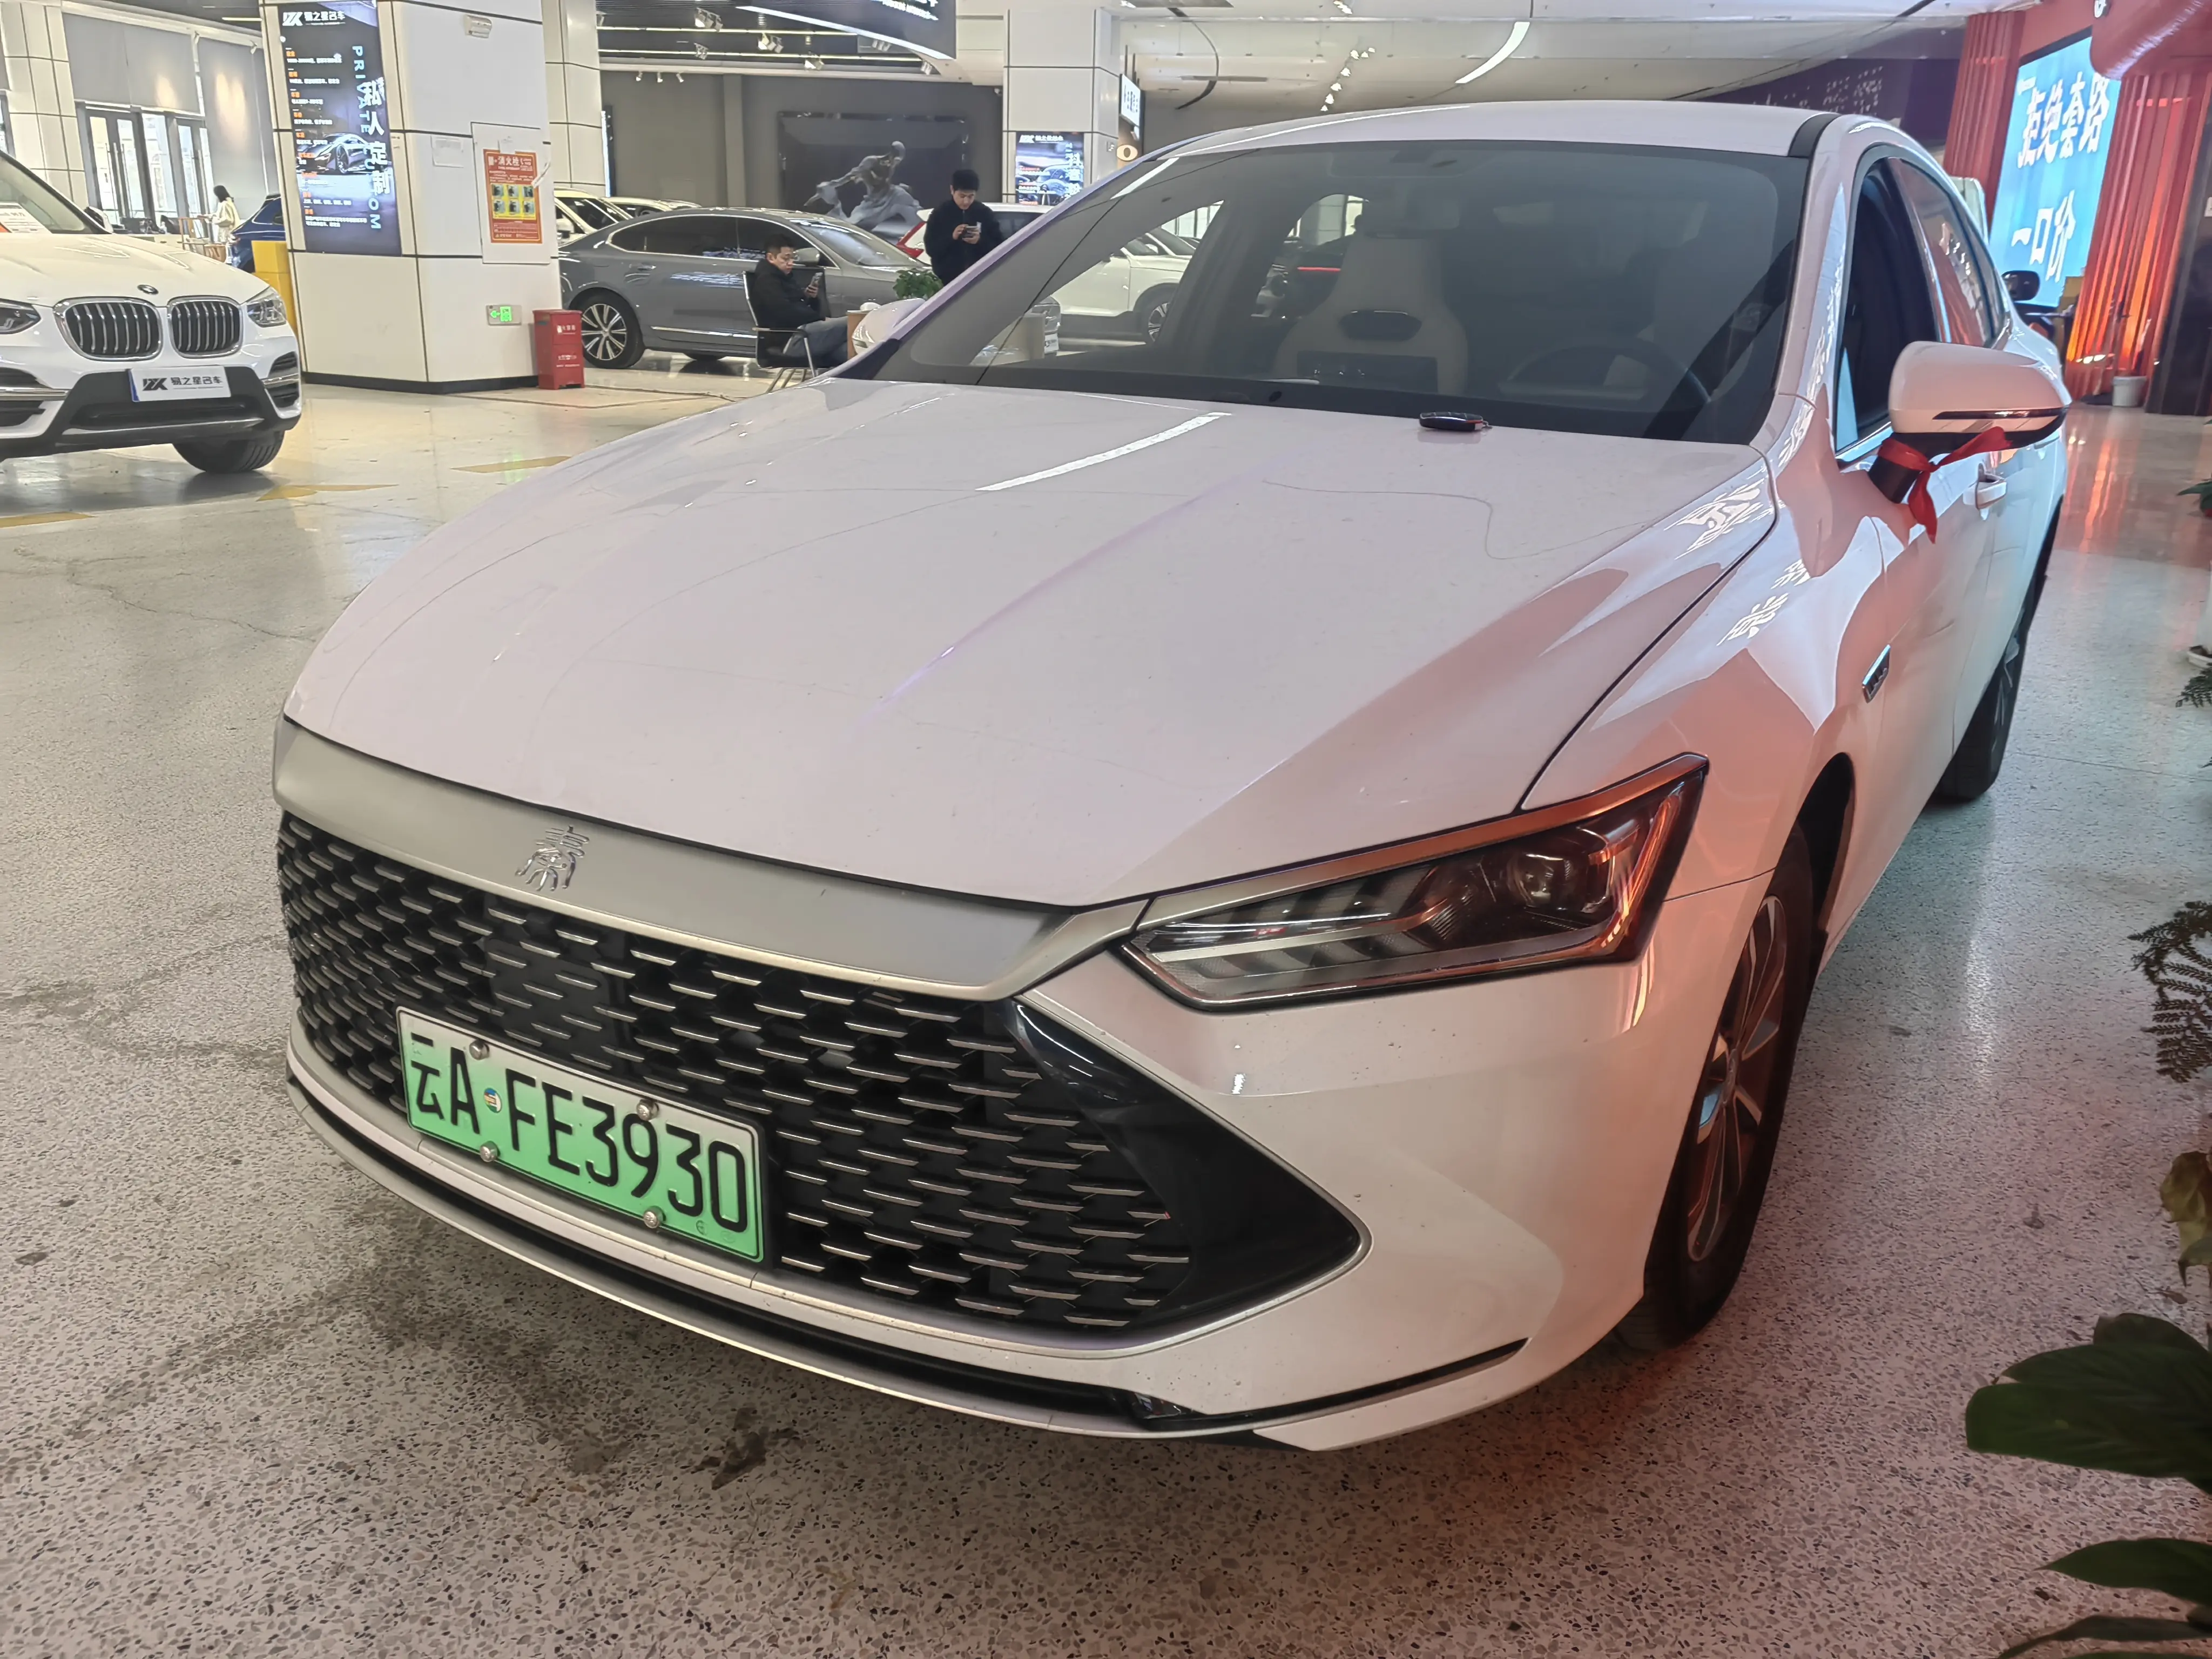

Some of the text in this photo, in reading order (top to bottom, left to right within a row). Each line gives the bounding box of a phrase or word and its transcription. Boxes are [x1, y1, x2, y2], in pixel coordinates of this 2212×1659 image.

[2011, 190, 2075, 282] 一口价
[171, 376, 223, 385] 易之星名车
